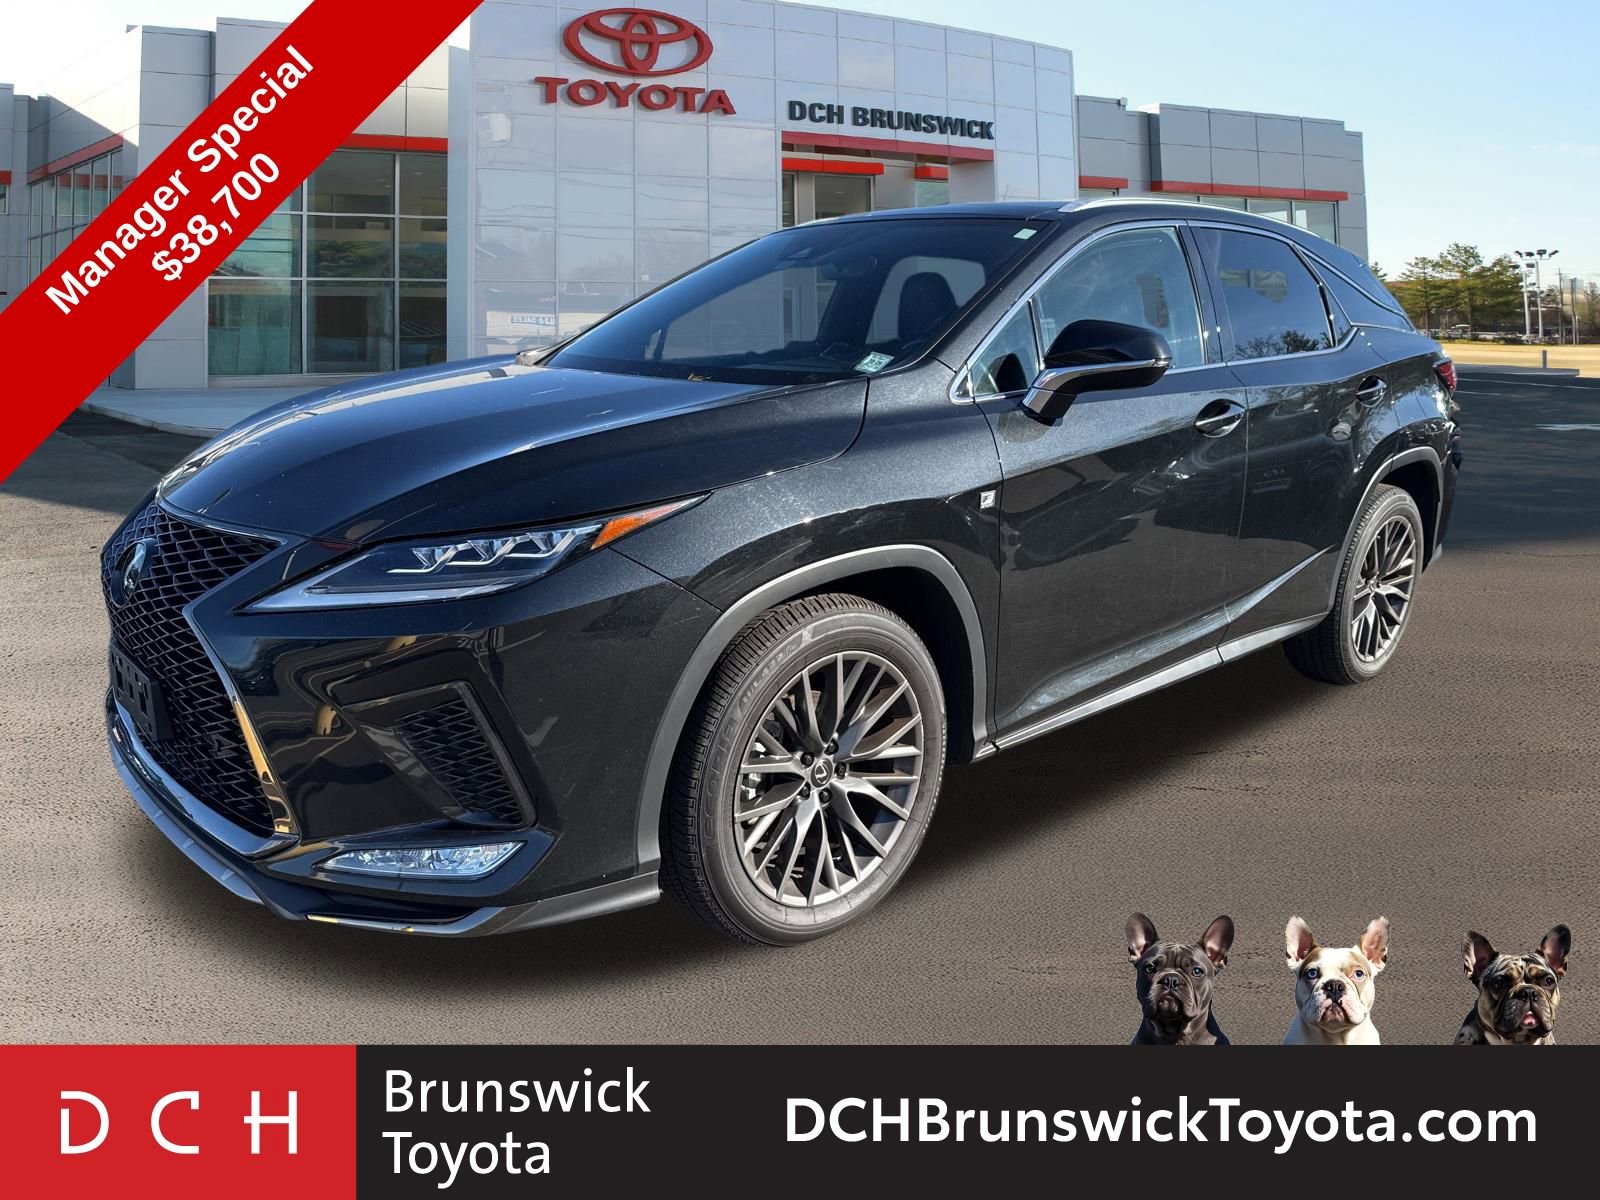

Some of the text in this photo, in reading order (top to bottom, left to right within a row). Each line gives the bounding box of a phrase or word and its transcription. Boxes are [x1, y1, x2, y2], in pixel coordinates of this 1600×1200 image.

[534, 76, 737, 115] TOYOTA
[788, 100, 995, 140] DCH BRUNSWICK
